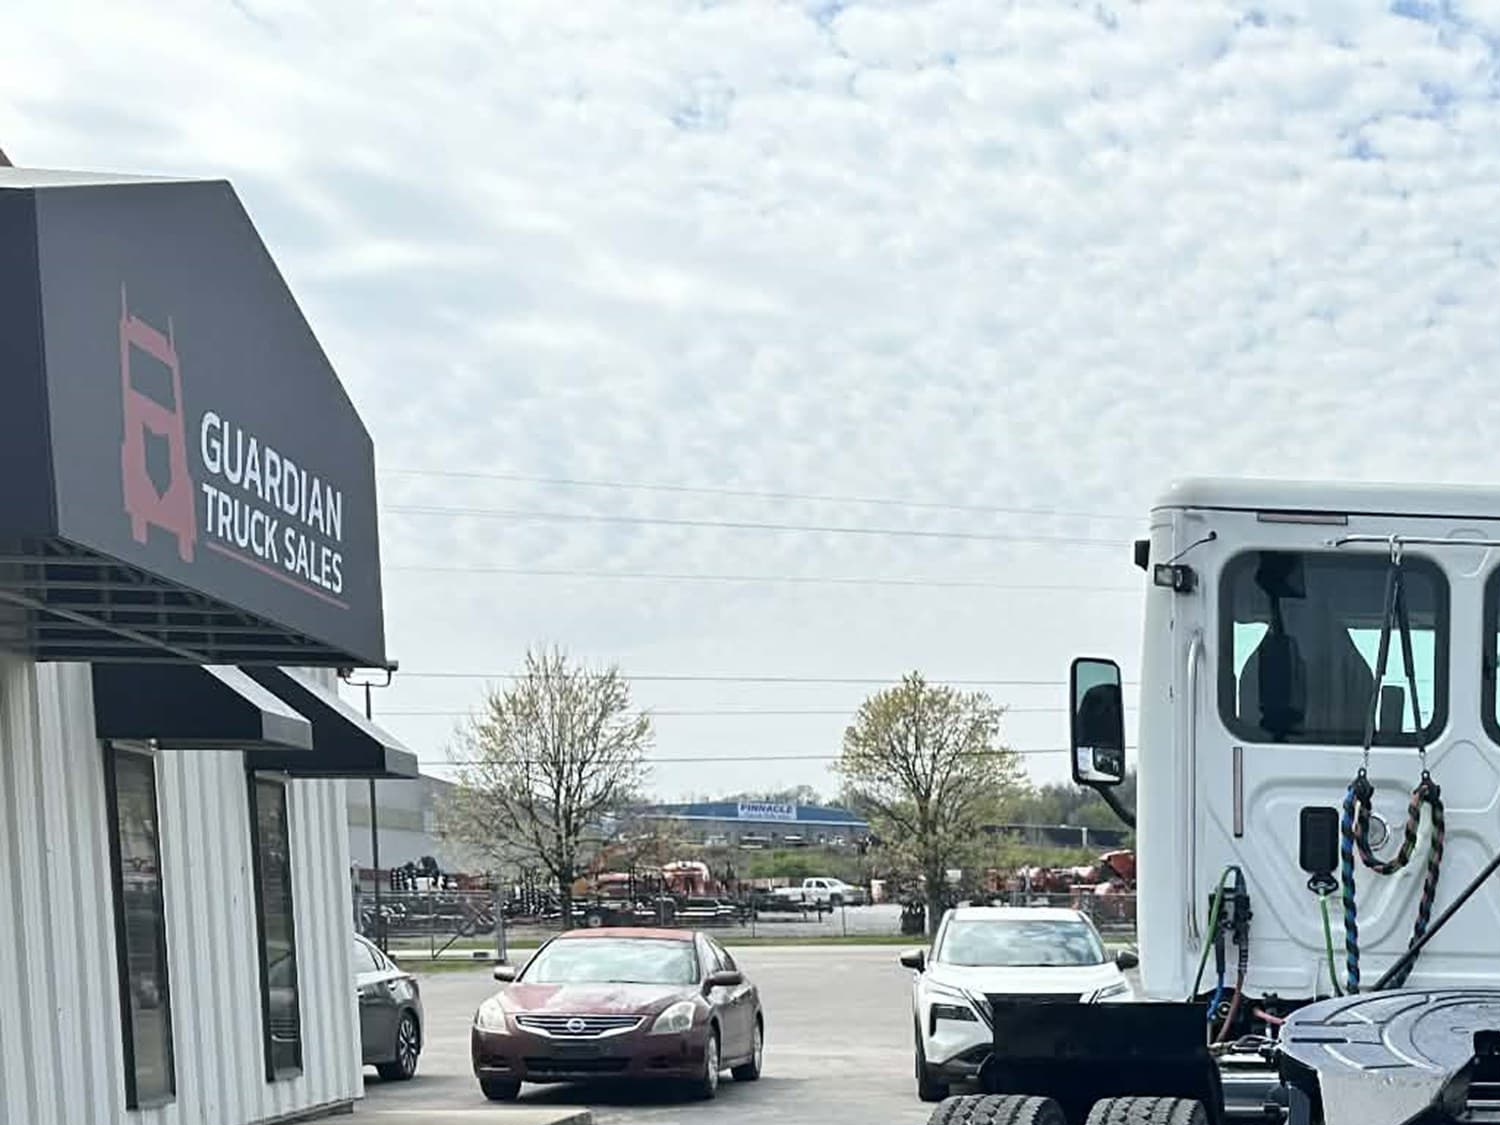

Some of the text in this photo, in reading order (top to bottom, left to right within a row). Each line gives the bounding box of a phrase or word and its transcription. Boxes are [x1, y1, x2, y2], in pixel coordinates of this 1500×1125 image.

[201, 411, 342, 541] GUARDIAN
[202, 483, 342, 594] TRUCK SALES
[740, 803, 793, 814] PINNACLE
